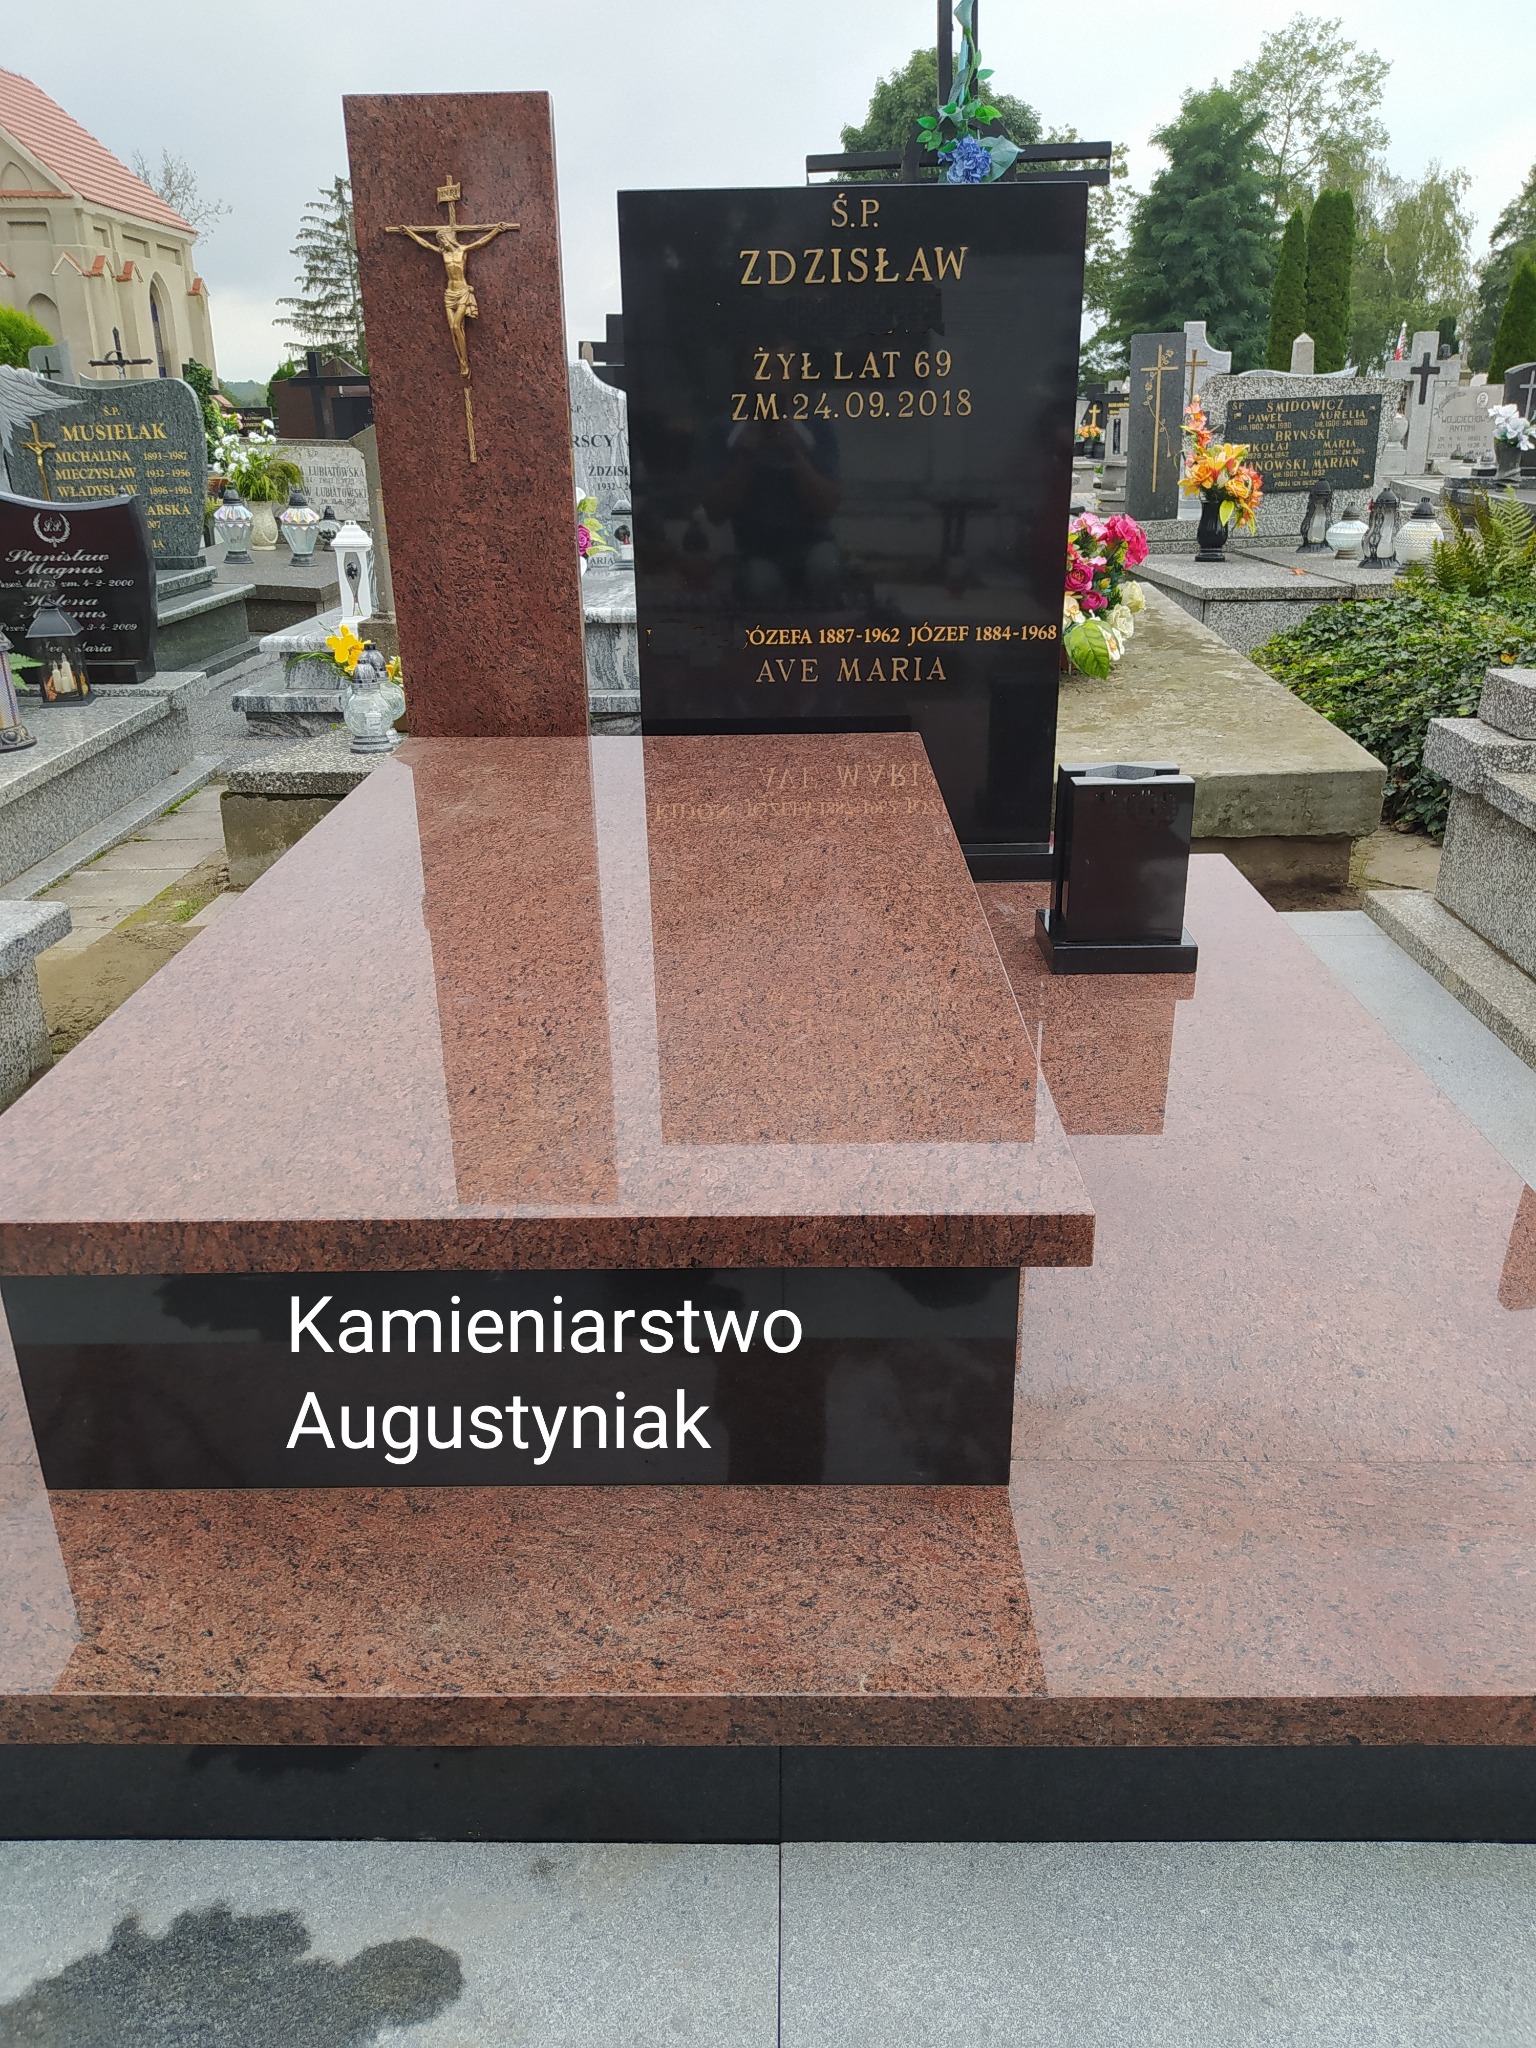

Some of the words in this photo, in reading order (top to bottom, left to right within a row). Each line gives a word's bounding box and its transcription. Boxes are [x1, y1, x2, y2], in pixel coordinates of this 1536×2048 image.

[831, 193, 880, 228] Ś.P.
[739, 246, 968, 285] ZDZISŁAW
[753, 347, 821, 380] ŻYŁ
[834, 351, 900, 380] LAT
[914, 349, 951, 377] 69
[1319, 409, 1366, 420] AURELIA
[61, 422, 168, 441] MUSIELAK
[1246, 442, 1290, 453] IKOŁAJ
[1323, 438, 1357, 448] MARIA
[55, 450, 131, 463] MICHALINA
[1312, 456, 1359, 469] MARIAN
[55, 467, 137, 480] MIECZYSŁAW
[57, 484, 137, 497] WŁADYSŁW
[15, 562, 104, 579] Magnus
[907, 622, 969, 647] JÓZEF
[755, 658, 819, 683] AVE
[836, 656, 947, 682] MARIA
